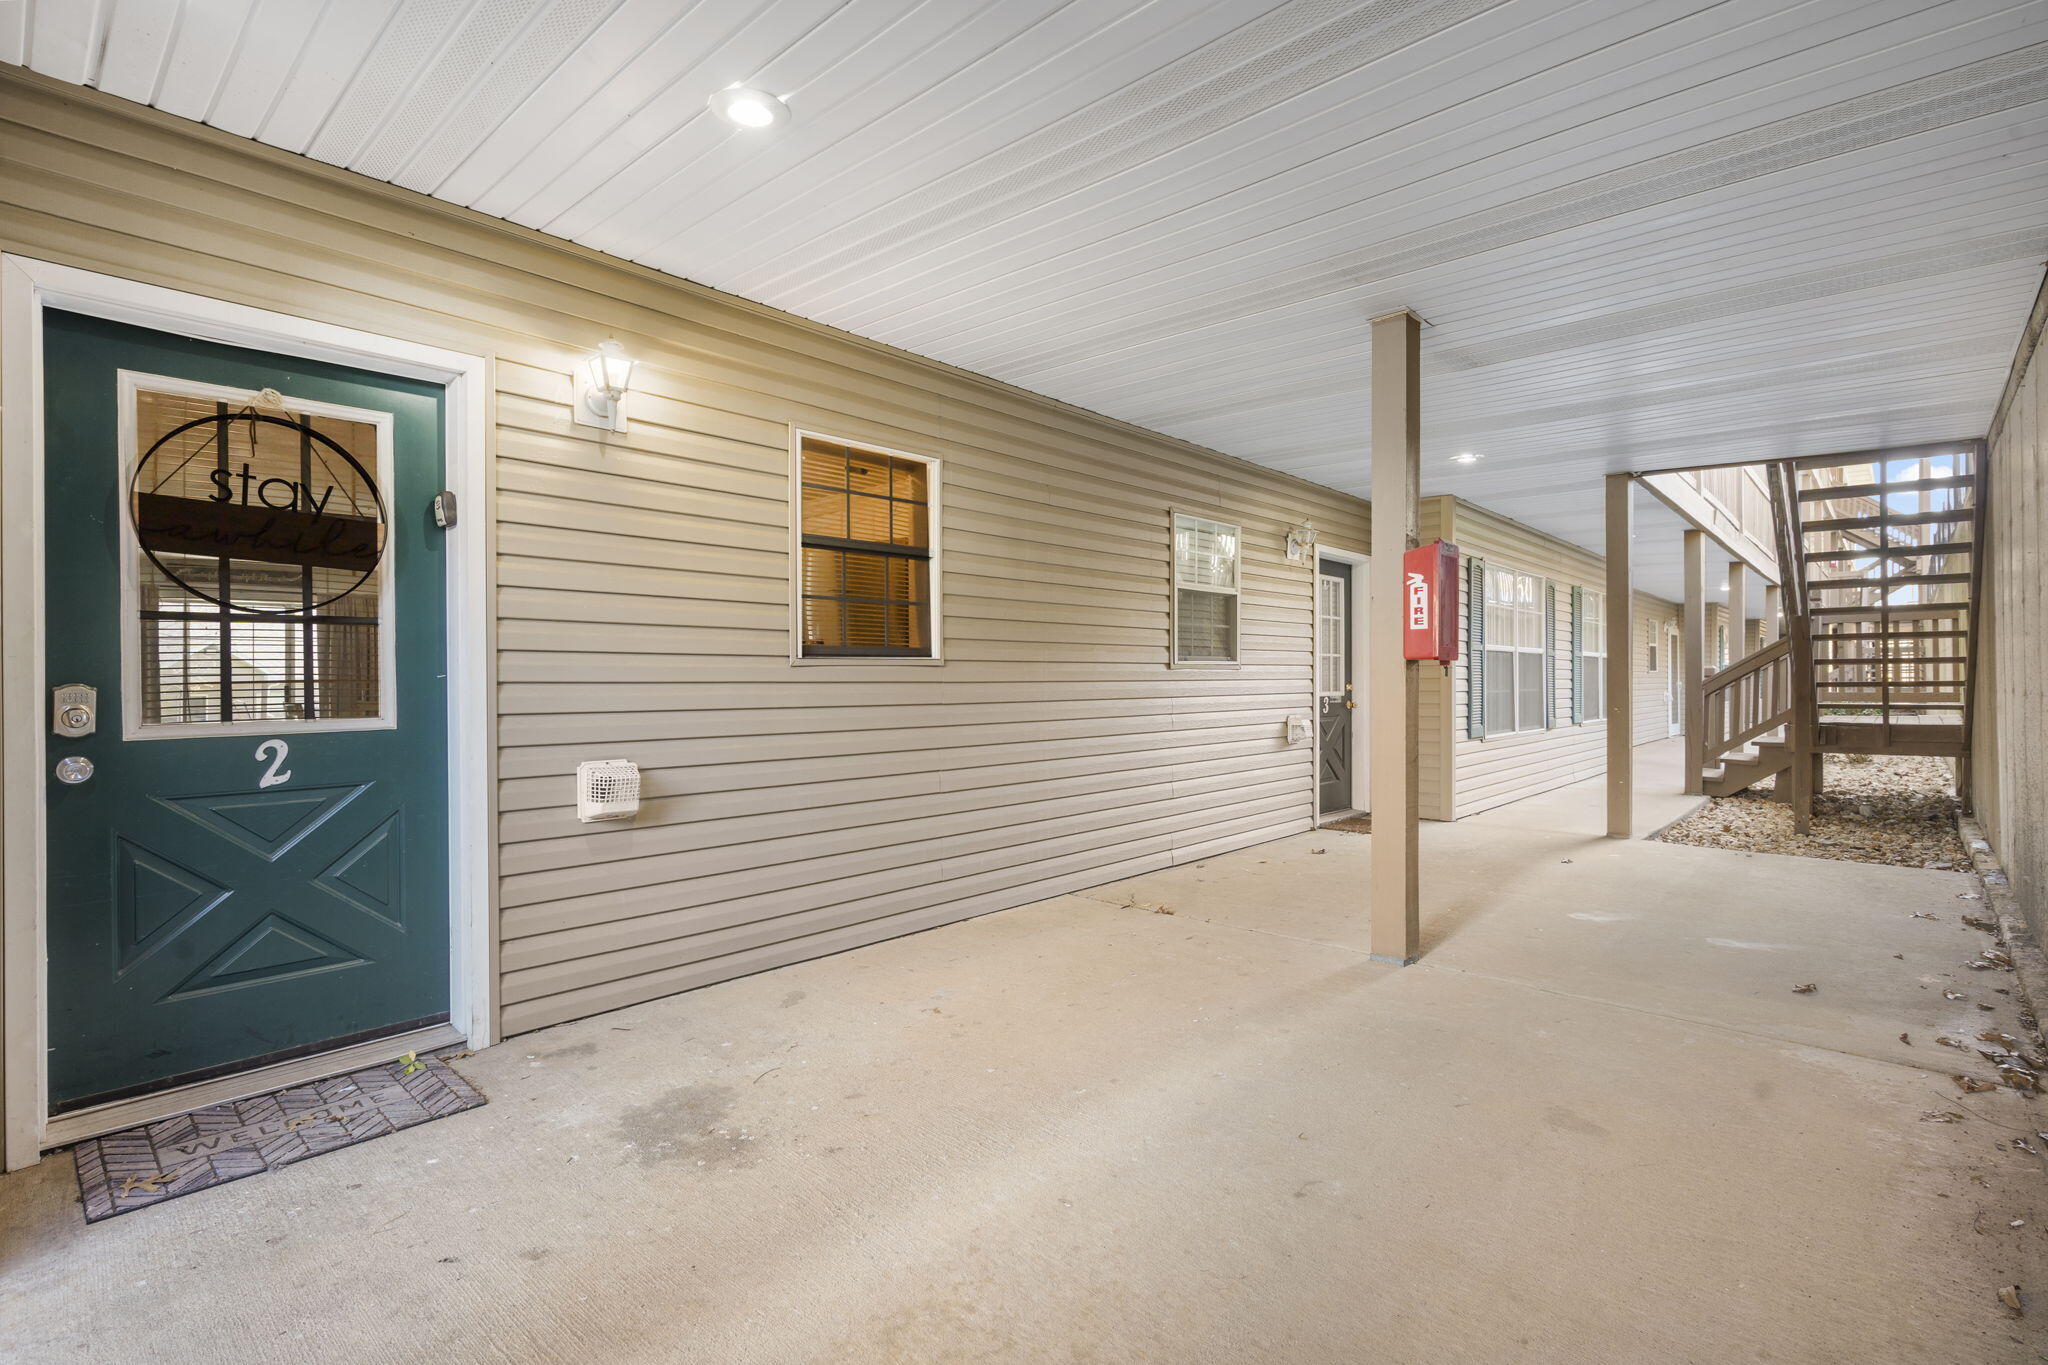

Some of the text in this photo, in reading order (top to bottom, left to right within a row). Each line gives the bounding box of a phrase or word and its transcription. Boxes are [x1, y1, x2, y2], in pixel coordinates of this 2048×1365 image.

[208, 463, 334, 524] stay
[1413, 586, 1424, 625] FIRE
[1322, 697, 1330, 714] 3
[255, 738, 291, 789] 2
